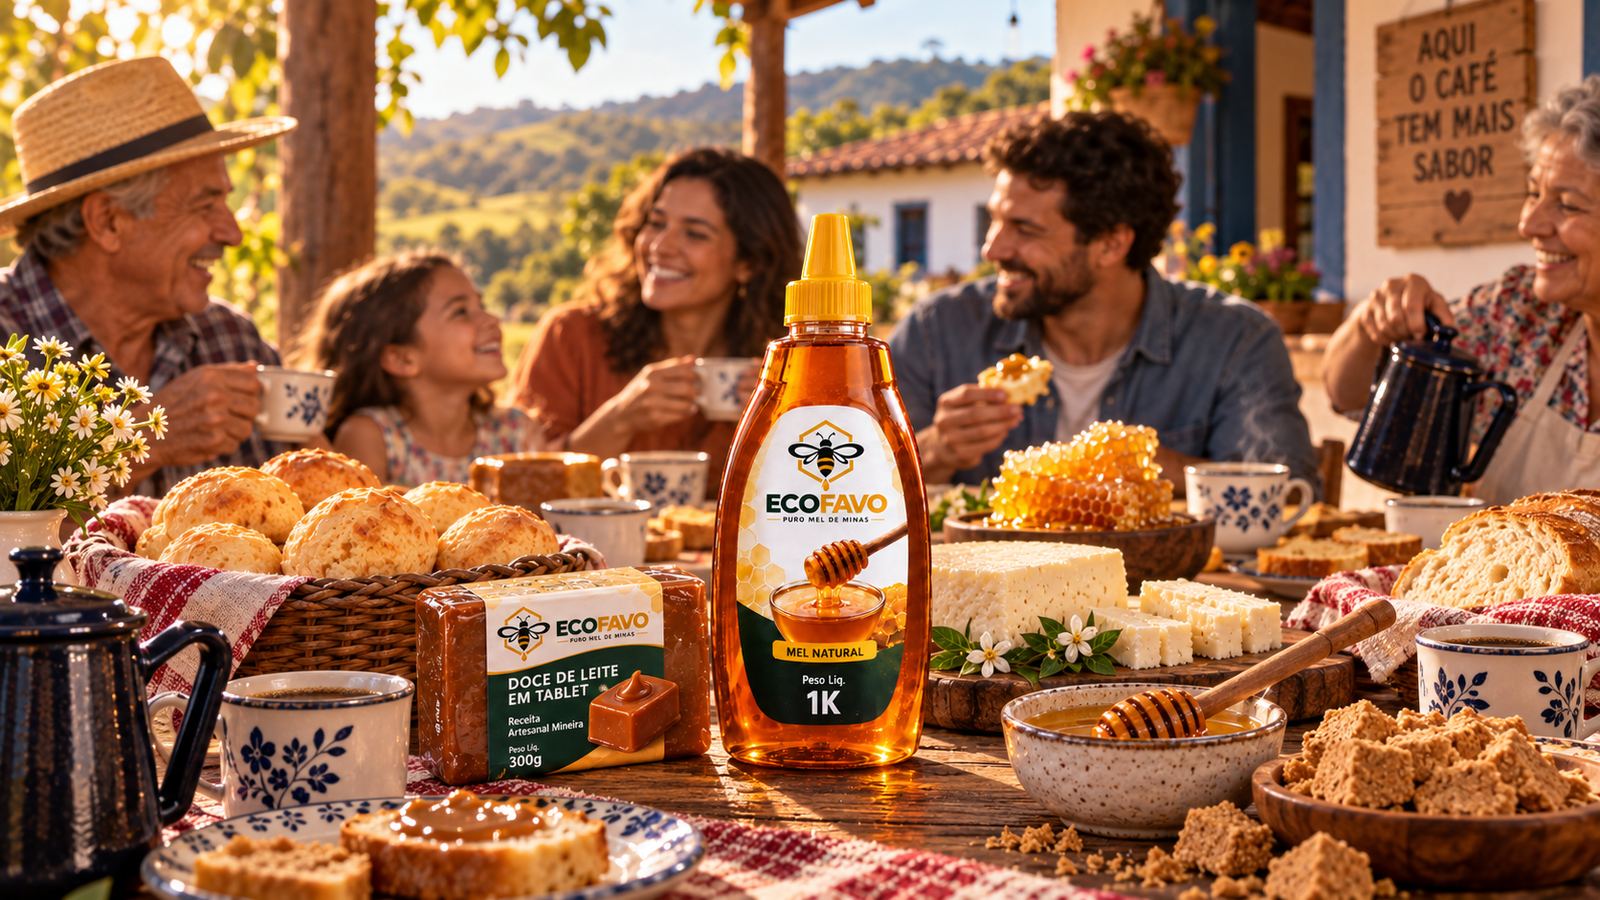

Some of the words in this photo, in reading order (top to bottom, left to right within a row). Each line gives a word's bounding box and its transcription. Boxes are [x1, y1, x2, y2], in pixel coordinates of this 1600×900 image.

[1417, 22, 1475, 63] AQUI
[1409, 72, 1426, 103] O
[1435, 50, 1498, 100] CAFÉ
[1394, 109, 1442, 144] TEM
[1453, 100, 1515, 138] MAIS
[1414, 145, 1494, 182] SABOR
[766, 493, 888, 513] ECOFAVO
[556, 612, 650, 637] ECOFAVO
[786, 647, 809, 658] MEL
[812, 647, 864, 658] NATURAL
[508, 673, 551, 690] DOCE
[556, 670, 576, 684] DE
[580, 665, 619, 681] LEITE
[802, 675, 825, 685] Peso
[508, 691, 531, 706] EM
[535, 684, 589, 701] TABLET
[807, 690, 841, 715] 1K
[508, 715, 541, 726] Receita
[508, 724, 549, 737] Artesanal
[551, 720, 584, 732] Mineira
[508, 746, 526, 754] Peso
[509, 754, 542, 768] 300g
